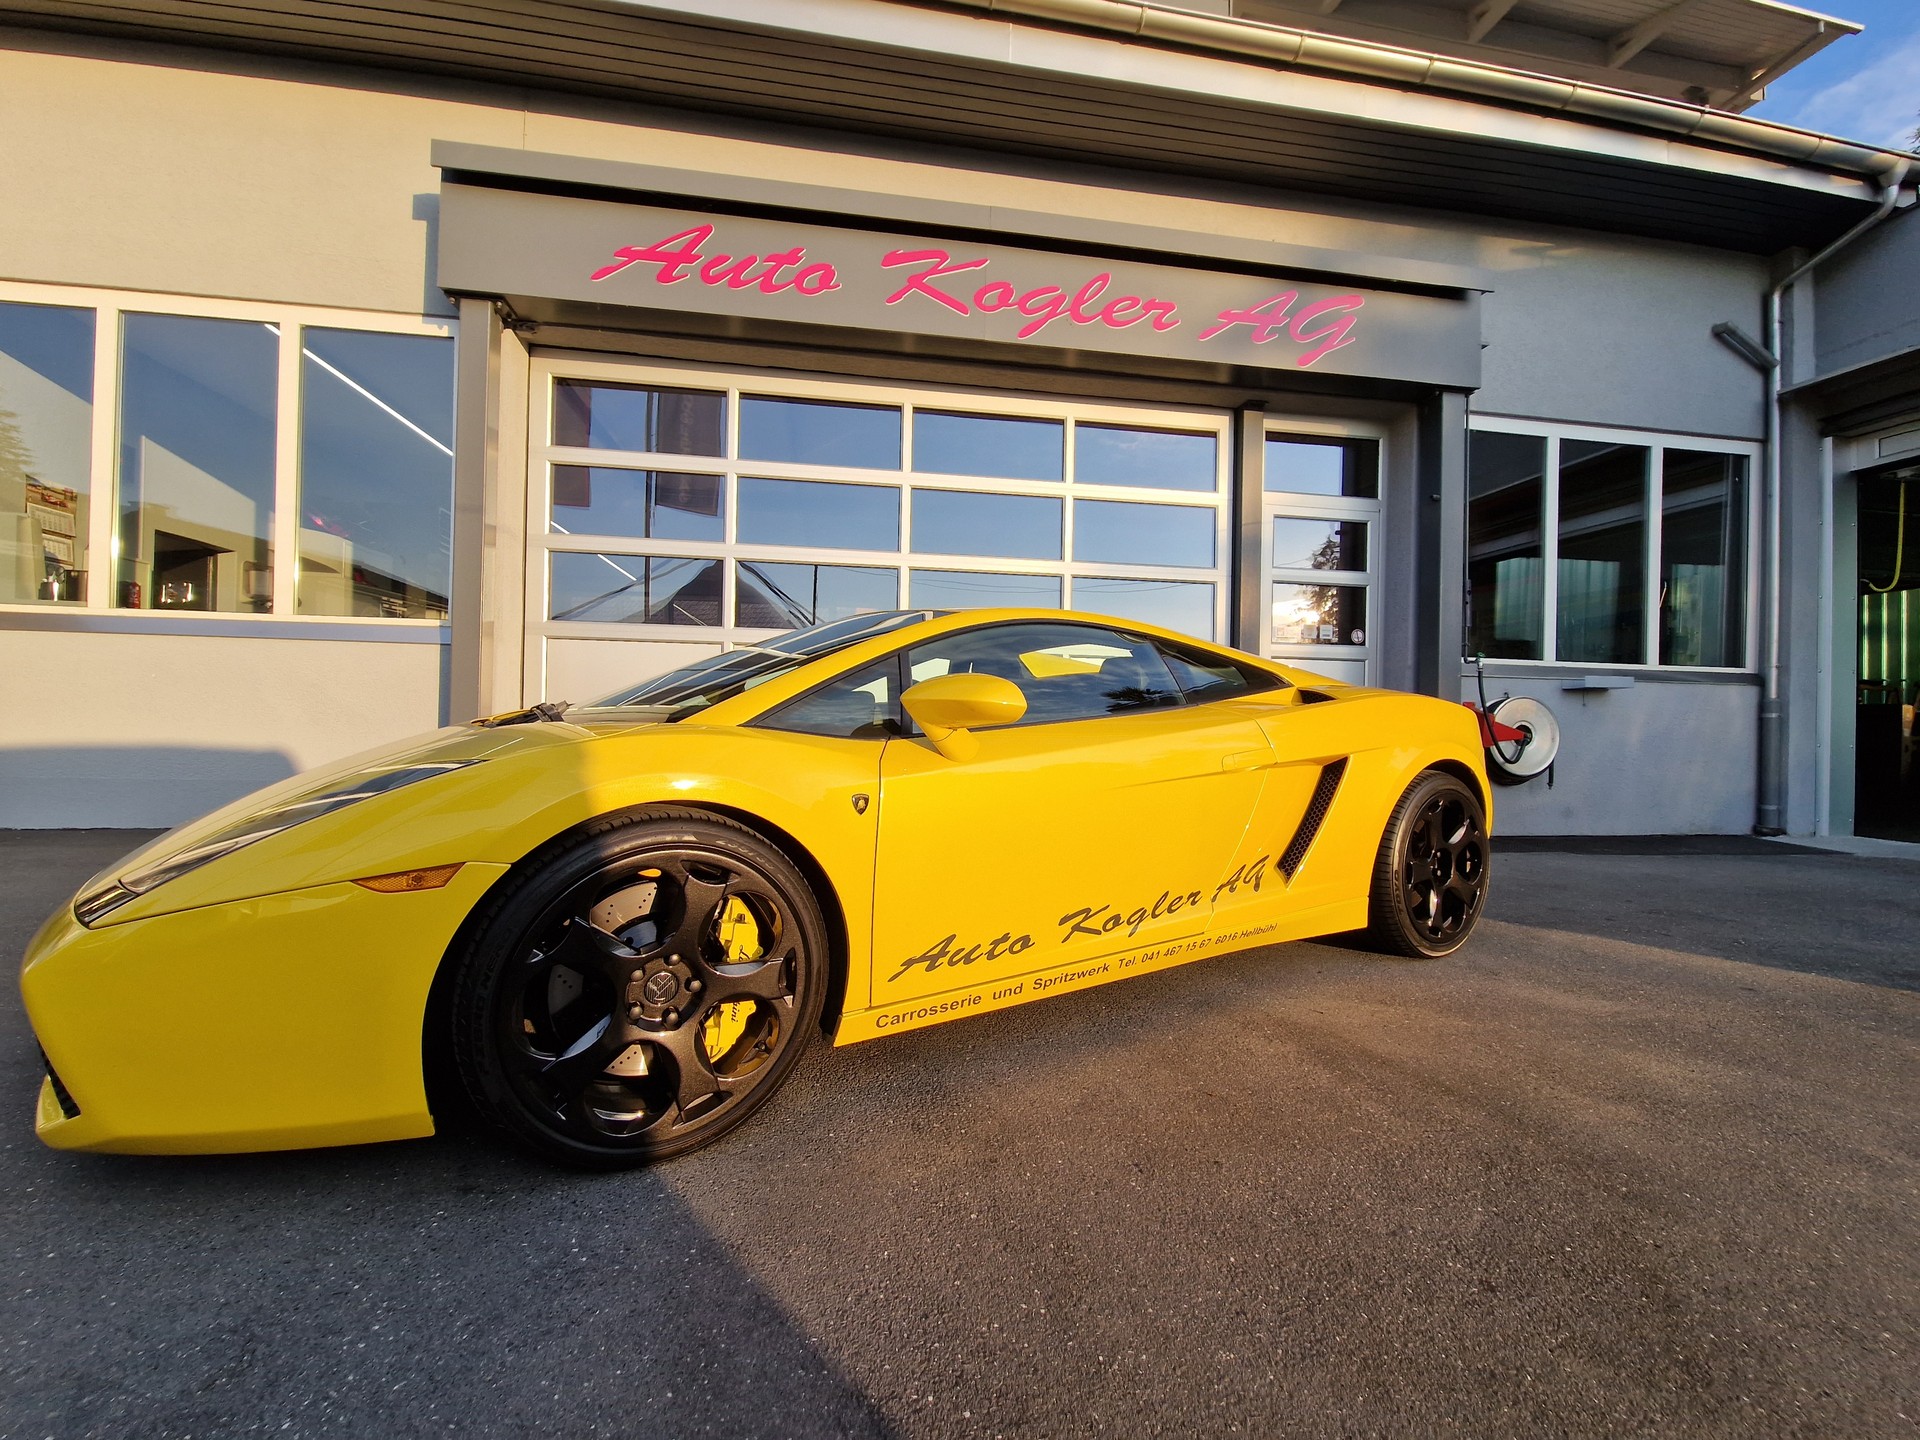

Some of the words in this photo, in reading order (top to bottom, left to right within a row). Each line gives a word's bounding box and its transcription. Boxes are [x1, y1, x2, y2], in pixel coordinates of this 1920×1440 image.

[591, 224, 842, 295] Auto
[881, 249, 1181, 340] Kogler
[1198, 289, 1366, 369] AG
[875, 994, 982, 1029] Carrosserie
[992, 983, 1024, 1001] und
[1032, 963, 1110, 991] Spritzwerk
[1118, 956, 1137, 969] Tel.
[1141, 950, 1161, 963] 041
[1163, 945, 1183, 958] 467
[1185, 942, 1197, 952] 15
[1199, 938, 1212, 949] 67
[1215, 931, 1239, 945] 6016
[1239, 923, 1278, 939] Hellbühl
[887, 931, 1036, 983] Auto
[1057, 890, 1203, 943] Kogler
[1210, 854, 1270, 902] AG
